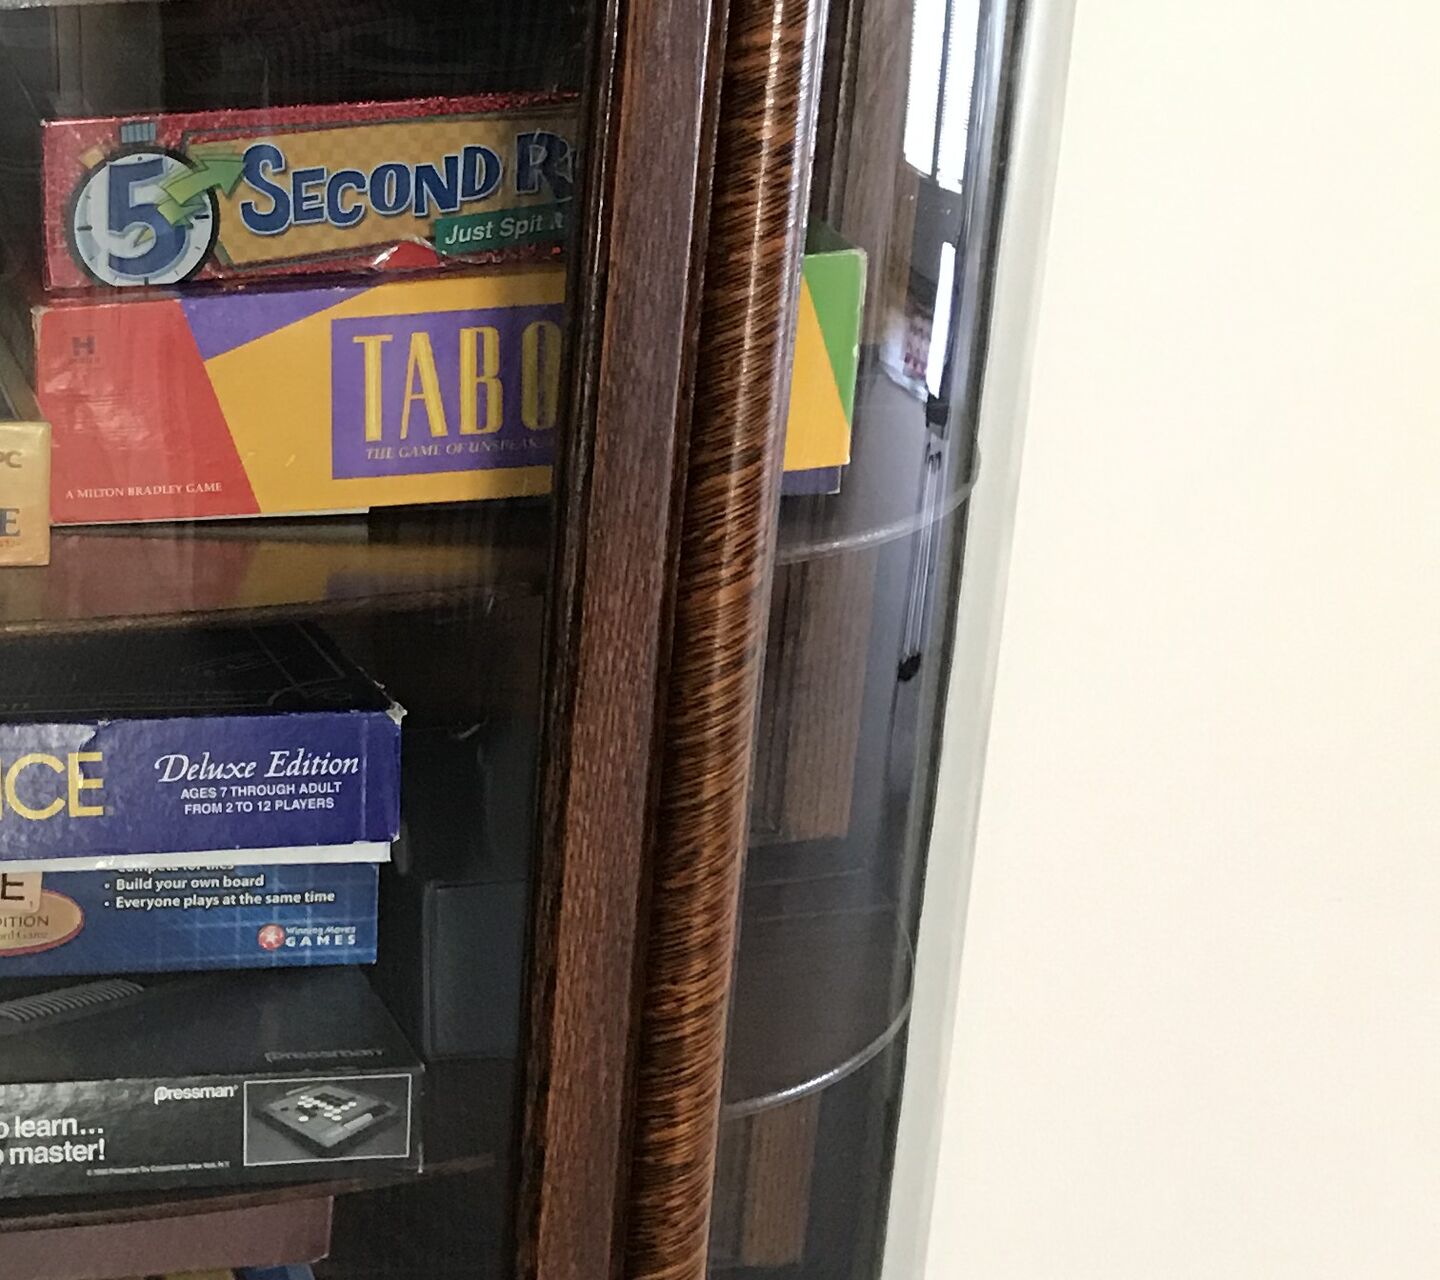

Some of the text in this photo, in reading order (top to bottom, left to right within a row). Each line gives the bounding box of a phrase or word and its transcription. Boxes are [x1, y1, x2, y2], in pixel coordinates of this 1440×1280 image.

[239, 142, 503, 237] SECOND
[105, 156, 192, 282] 5
[443, 213, 546, 247] Just Spit
[352, 320, 561, 443] TABO
[365, 443, 465, 461] THE GAME OF
[65, 481, 224, 500] A MILTON BRADLEY GAME
[153, 748, 360, 784] Deluxe Edition
[180, 781, 342, 800] AGES 7 THROUGH ADULT
[184, 796, 335, 816] FROM 2 TO 12 PLAYERS
[116, 874, 265, 893] Build your own board
[115, 889, 335, 910] Everyone plays at the same time
[285, 926, 323, 938] Winning
[285, 935, 357, 948] GAMES
[12, 1115, 105, 1139] learn...
[23, 1138, 106, 1164] master!
